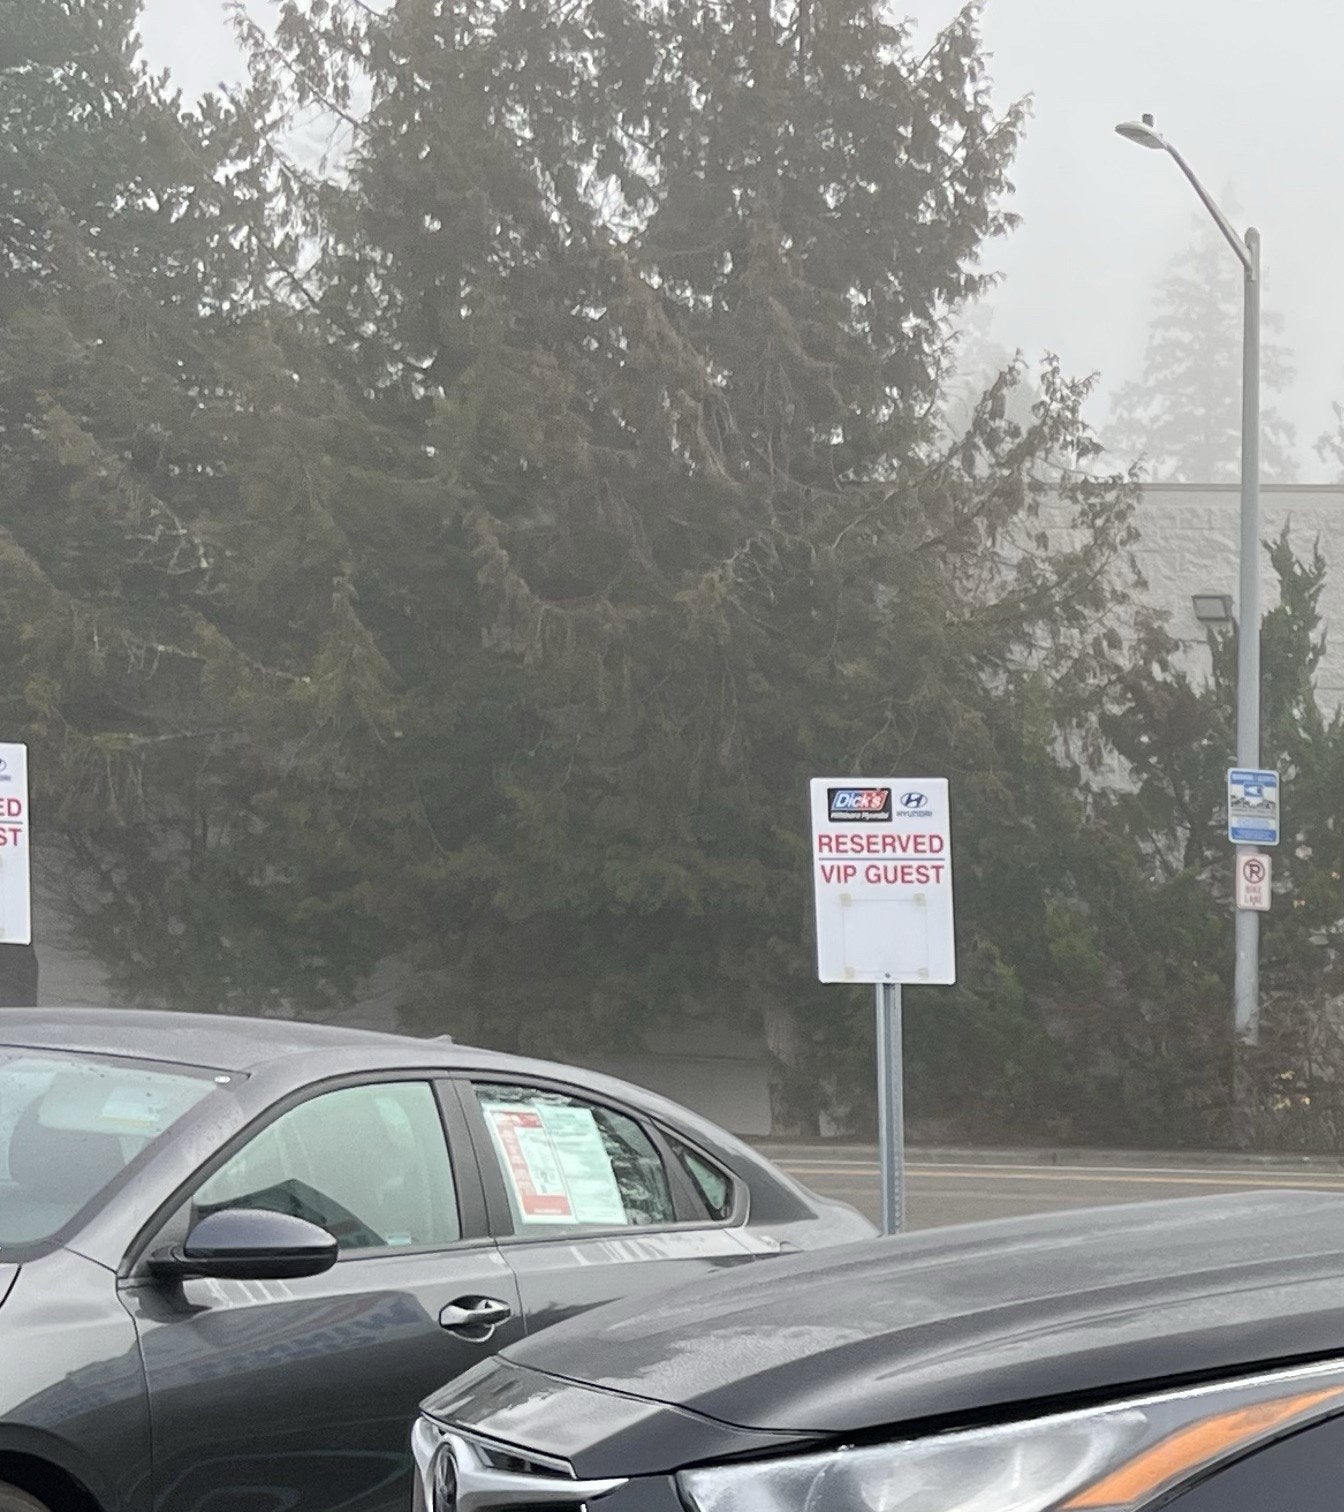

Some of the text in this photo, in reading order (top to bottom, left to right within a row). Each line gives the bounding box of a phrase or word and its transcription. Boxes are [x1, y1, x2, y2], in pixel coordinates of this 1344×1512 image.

[818, 834, 944, 853] RESERVED
[820, 864, 944, 885] VIP GUEST
